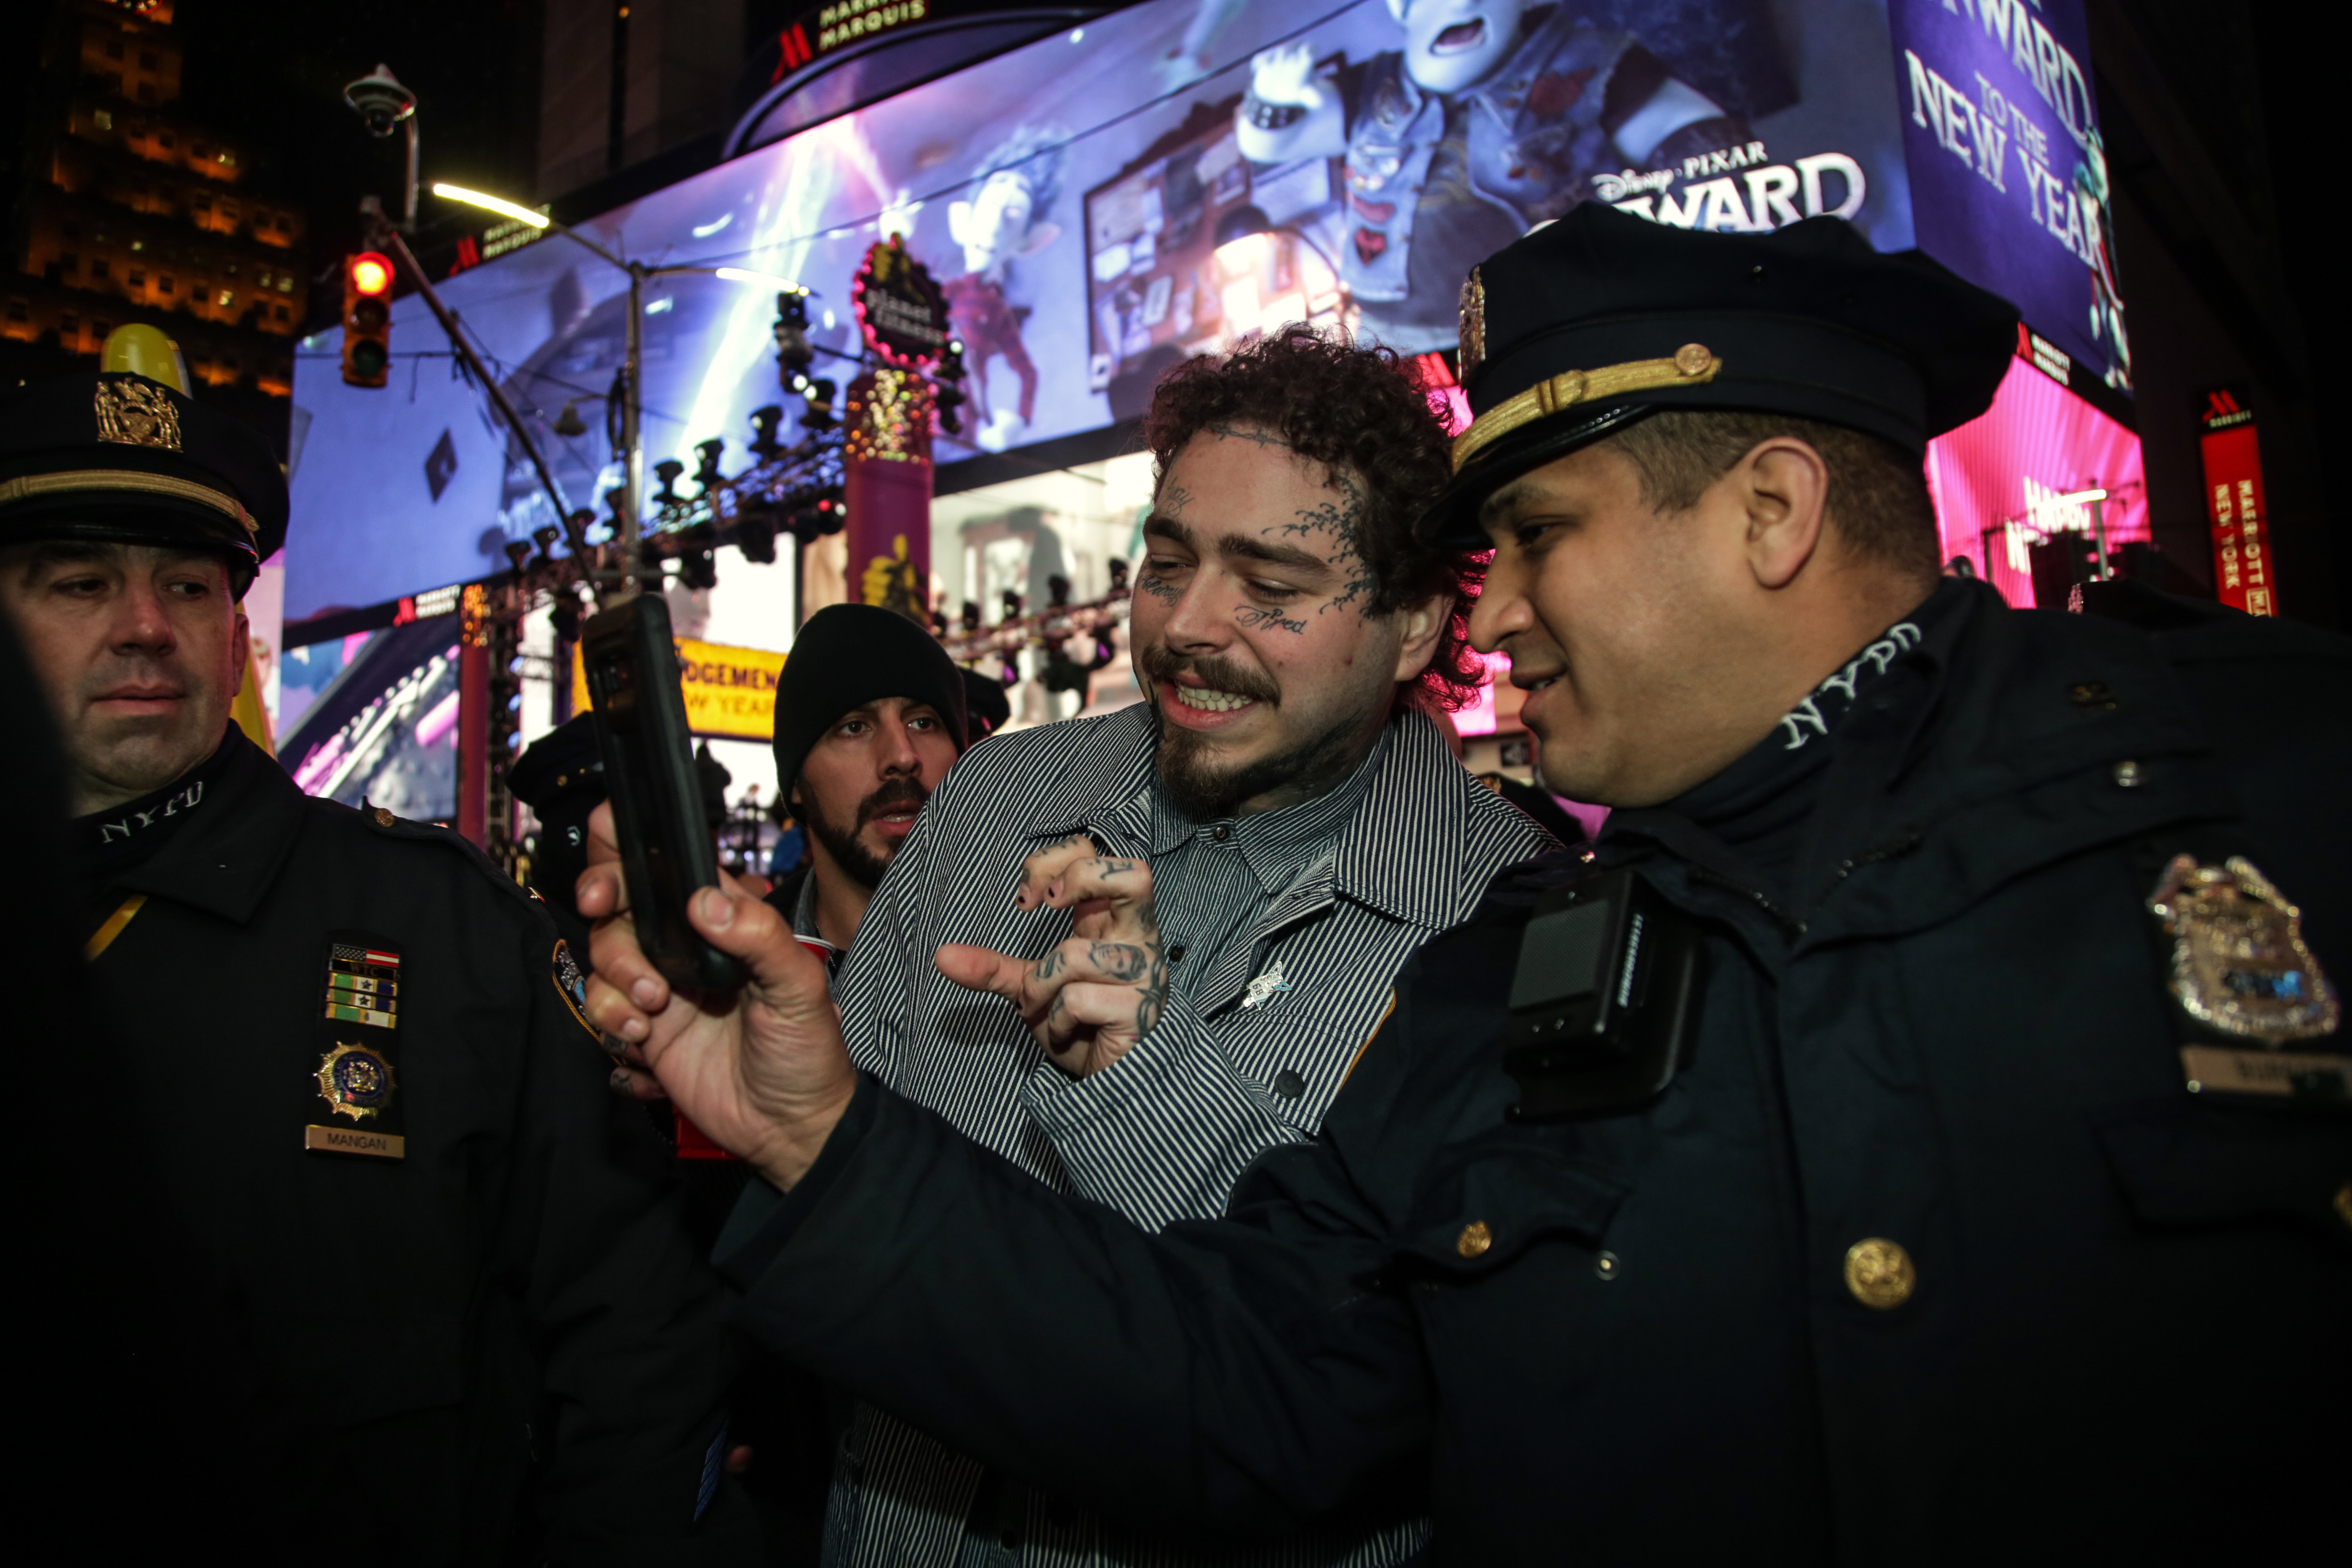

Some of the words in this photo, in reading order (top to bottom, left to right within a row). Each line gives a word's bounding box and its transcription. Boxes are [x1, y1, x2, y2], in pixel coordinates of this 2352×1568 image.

[819, 0, 926, 51] MARQUIS
[1904, 48, 2007, 194] NEW
[1974, 70, 2008, 127] TO
[2007, 100, 2050, 168] THE
[1682, 141, 1768, 179] PIXAR
[2215, 483, 2234, 528] NEW
[2221, 532, 2241, 590] YORK
[1780, 621, 1922, 750] NYPD
[350, 962, 380, 977] WTC
[327, 1131, 387, 1152] MANGAN
